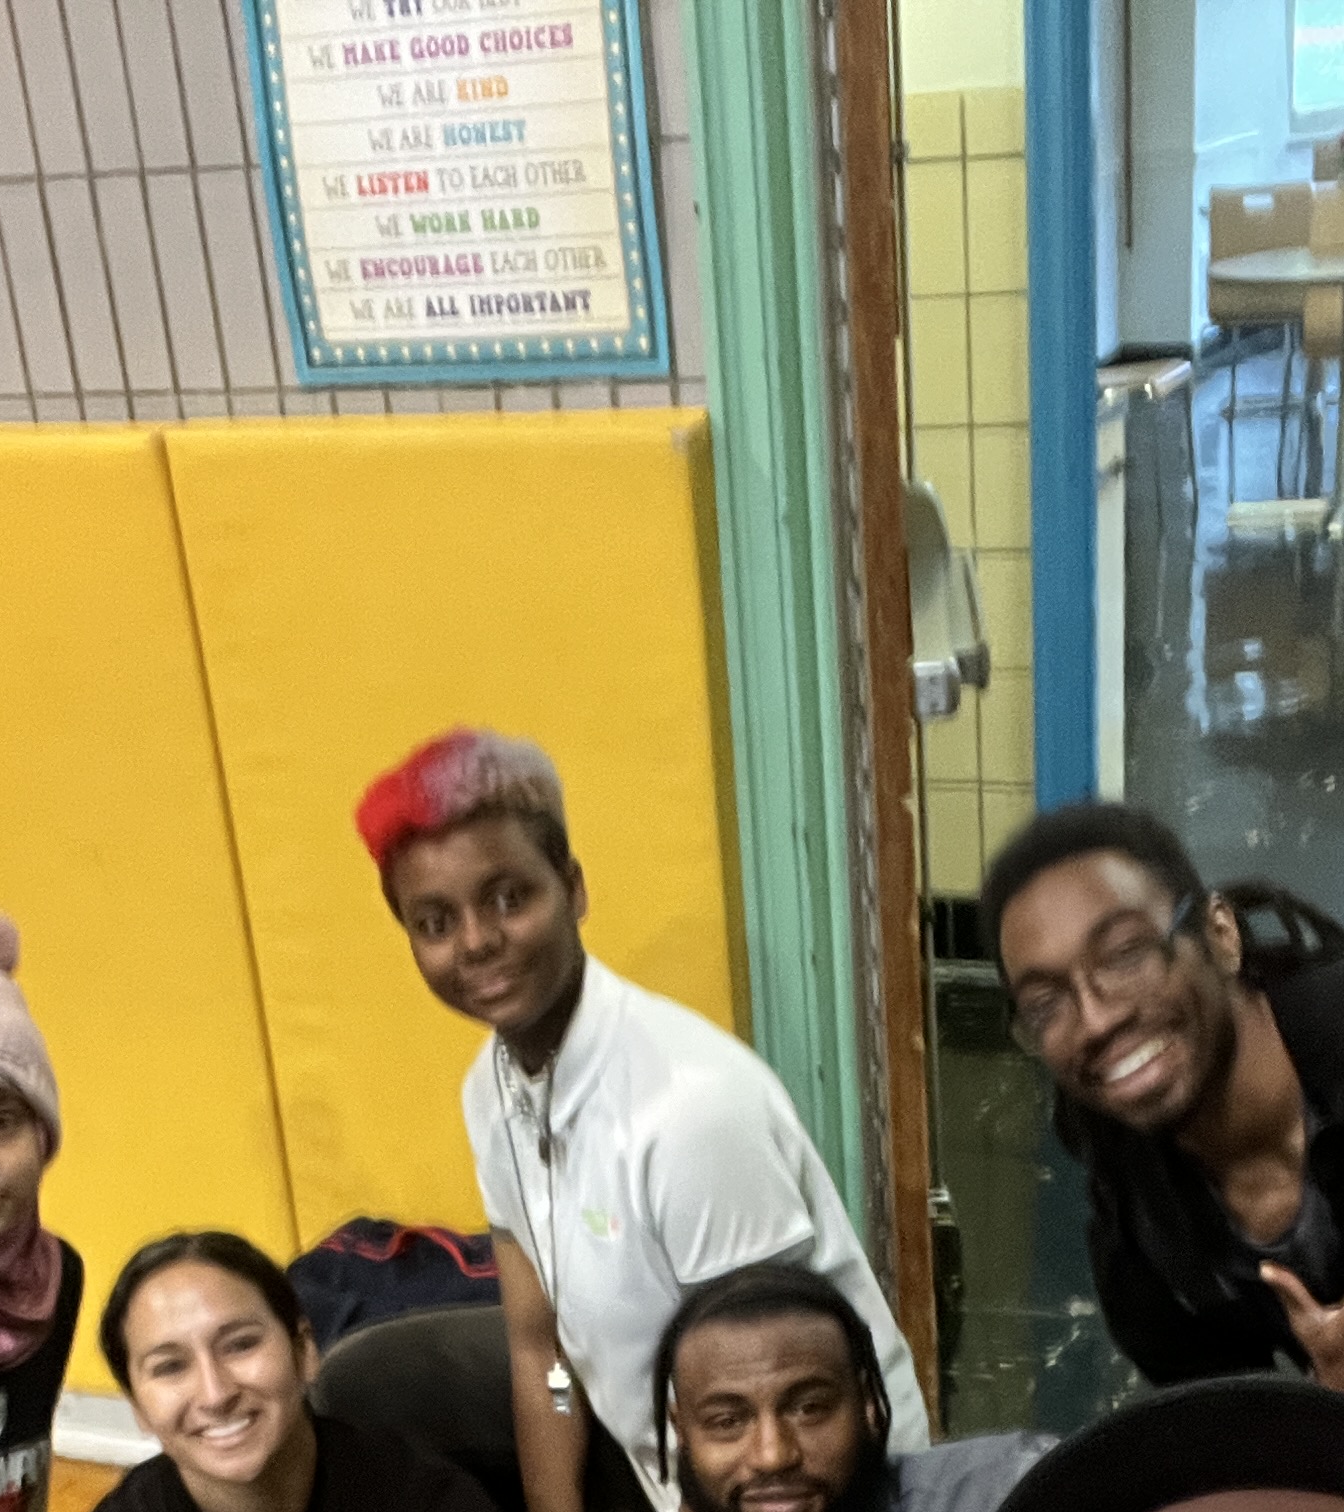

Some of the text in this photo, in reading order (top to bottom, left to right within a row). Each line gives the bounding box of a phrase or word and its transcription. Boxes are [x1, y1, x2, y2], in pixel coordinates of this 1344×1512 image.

[308, 23, 573, 69] WE MAKE GOOD CHOICES
[377, 75, 509, 107] WE ARE KIND
[367, 120, 526, 151] WE ARE HONEST
[323, 159, 586, 199] WE LISTEN TO EACH OTHER
[375, 207, 540, 238] WE WORK HARD
[325, 246, 607, 282] WE ENCOURAGE EACH OTHER
[349, 289, 591, 320] WE ARE ALL IMPORTANT
